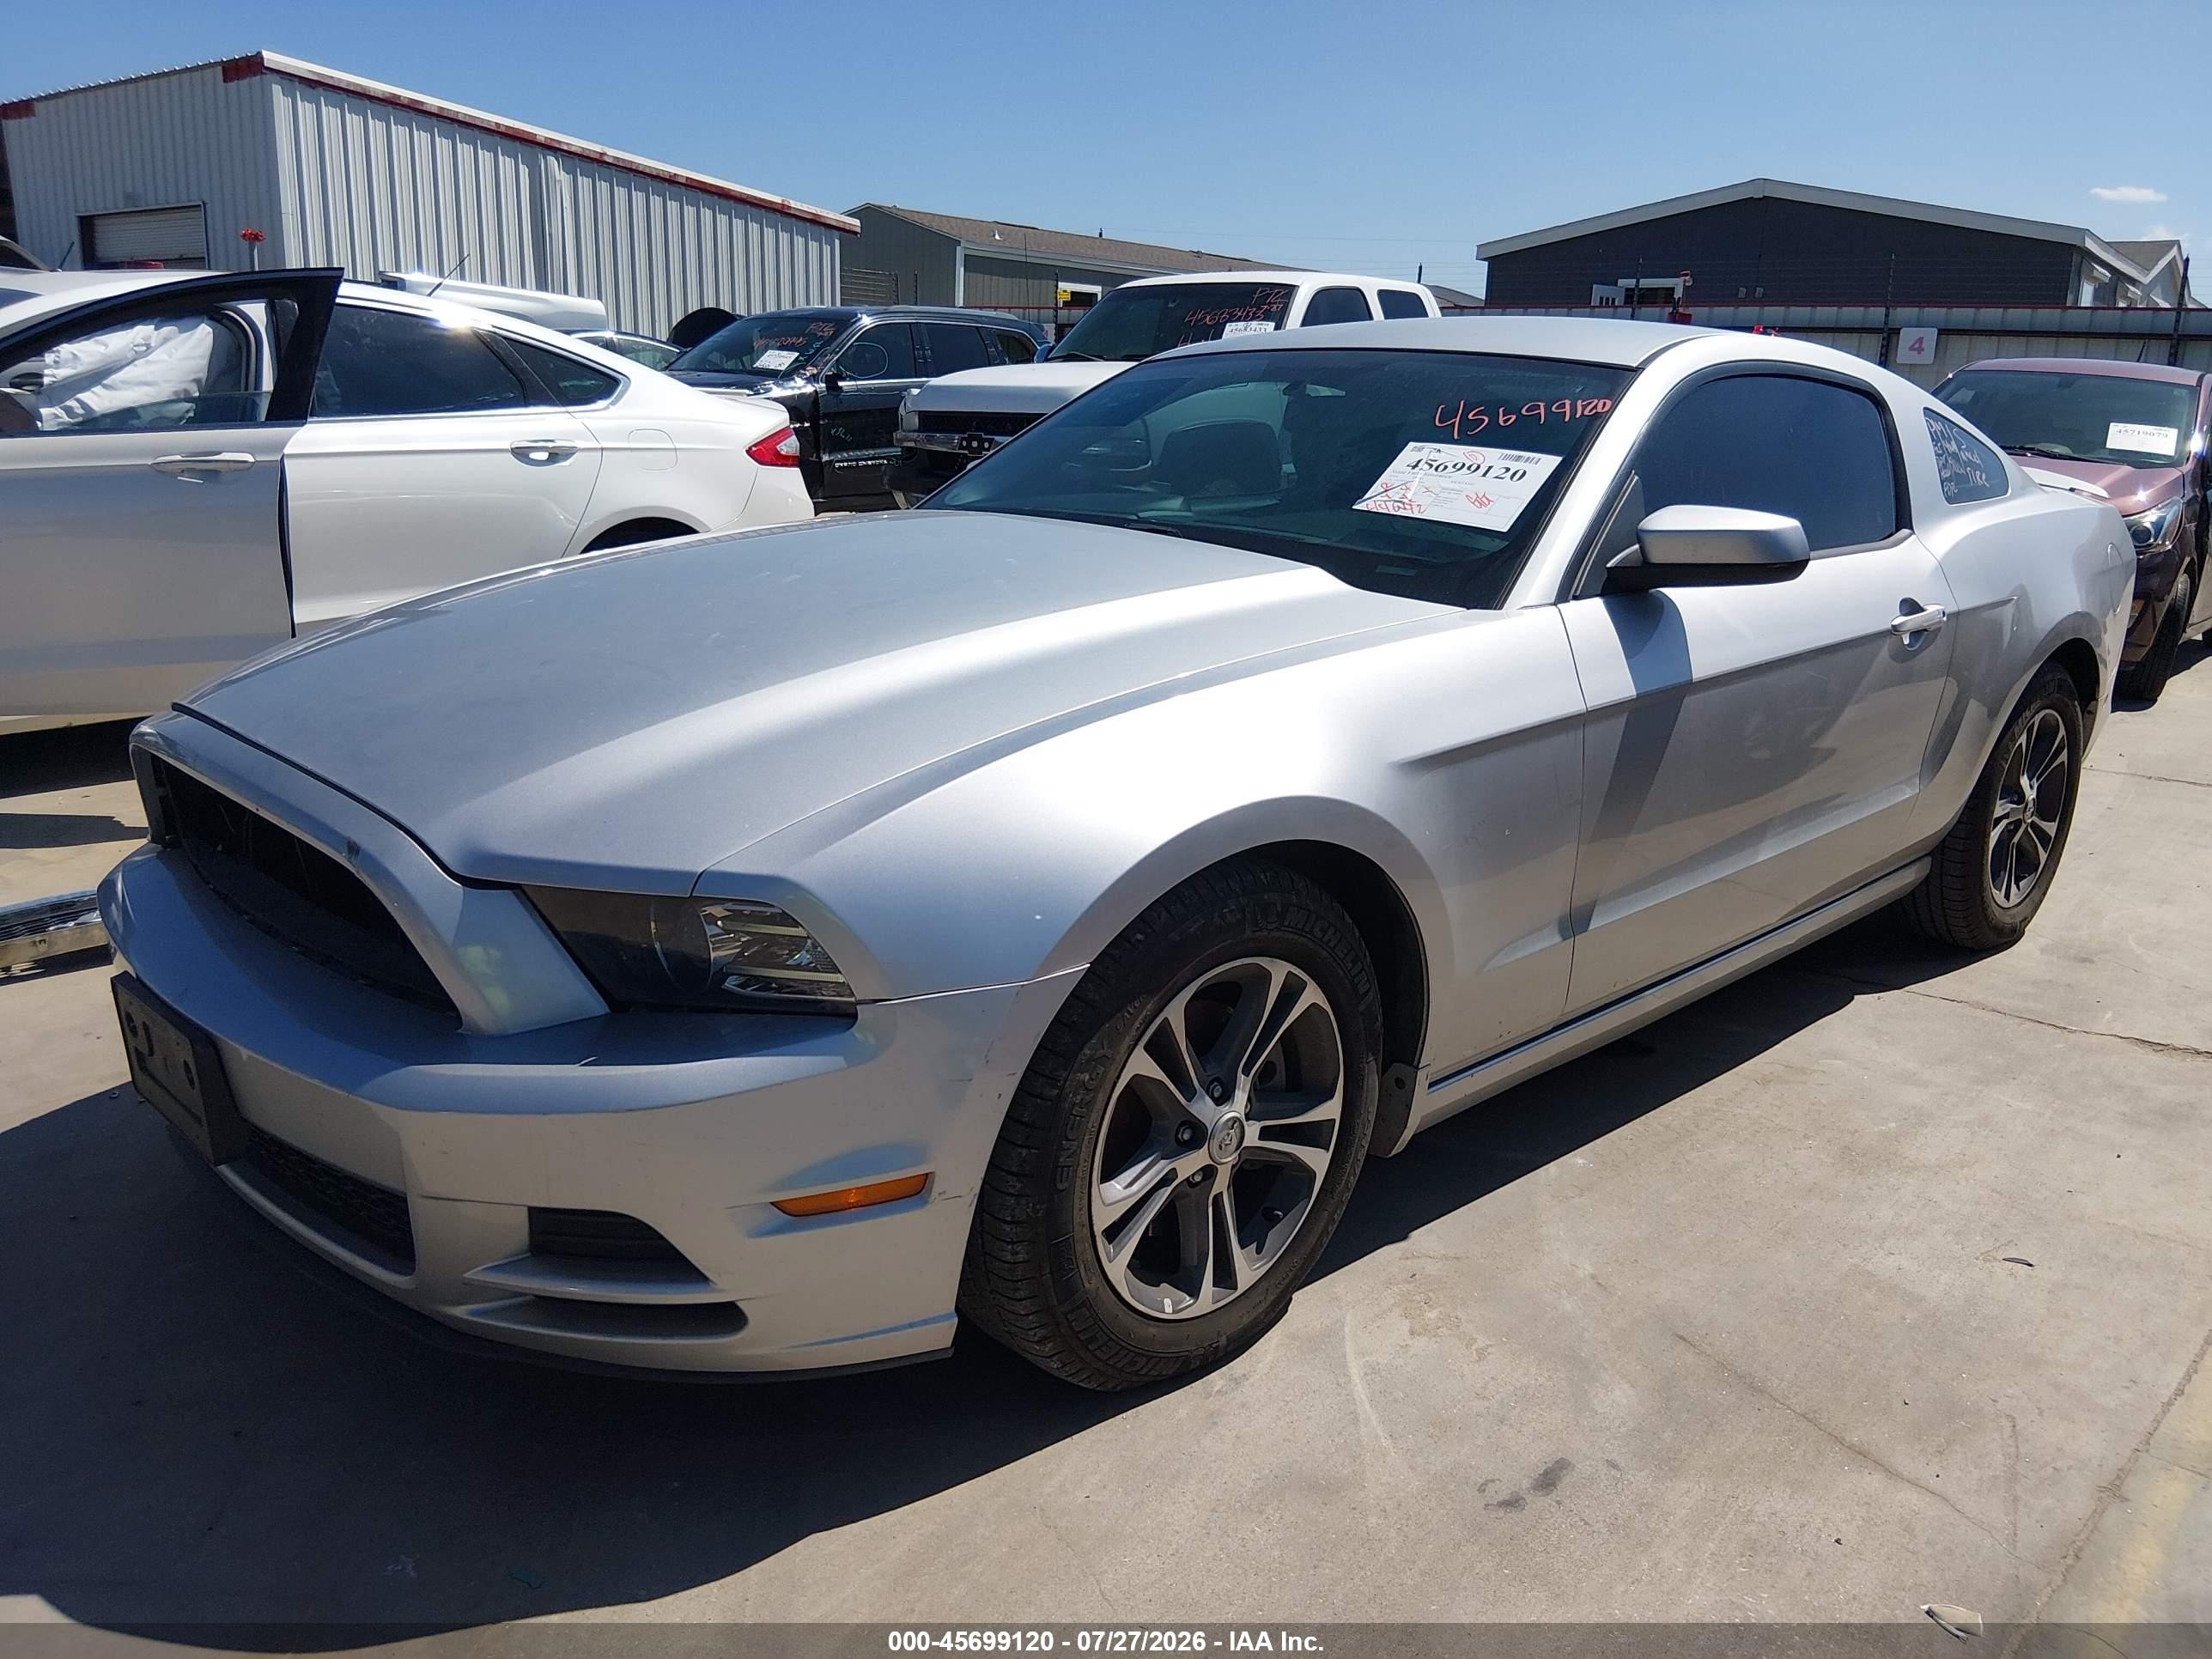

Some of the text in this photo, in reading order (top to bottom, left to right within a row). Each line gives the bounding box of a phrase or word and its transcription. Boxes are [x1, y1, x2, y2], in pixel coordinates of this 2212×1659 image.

[1908, 337, 1924, 354] 4
[1434, 398, 1613, 441] 45699120
[1405, 458, 1528, 483] 45699120
[1055, 1038, 1115, 1192] ENERGY
